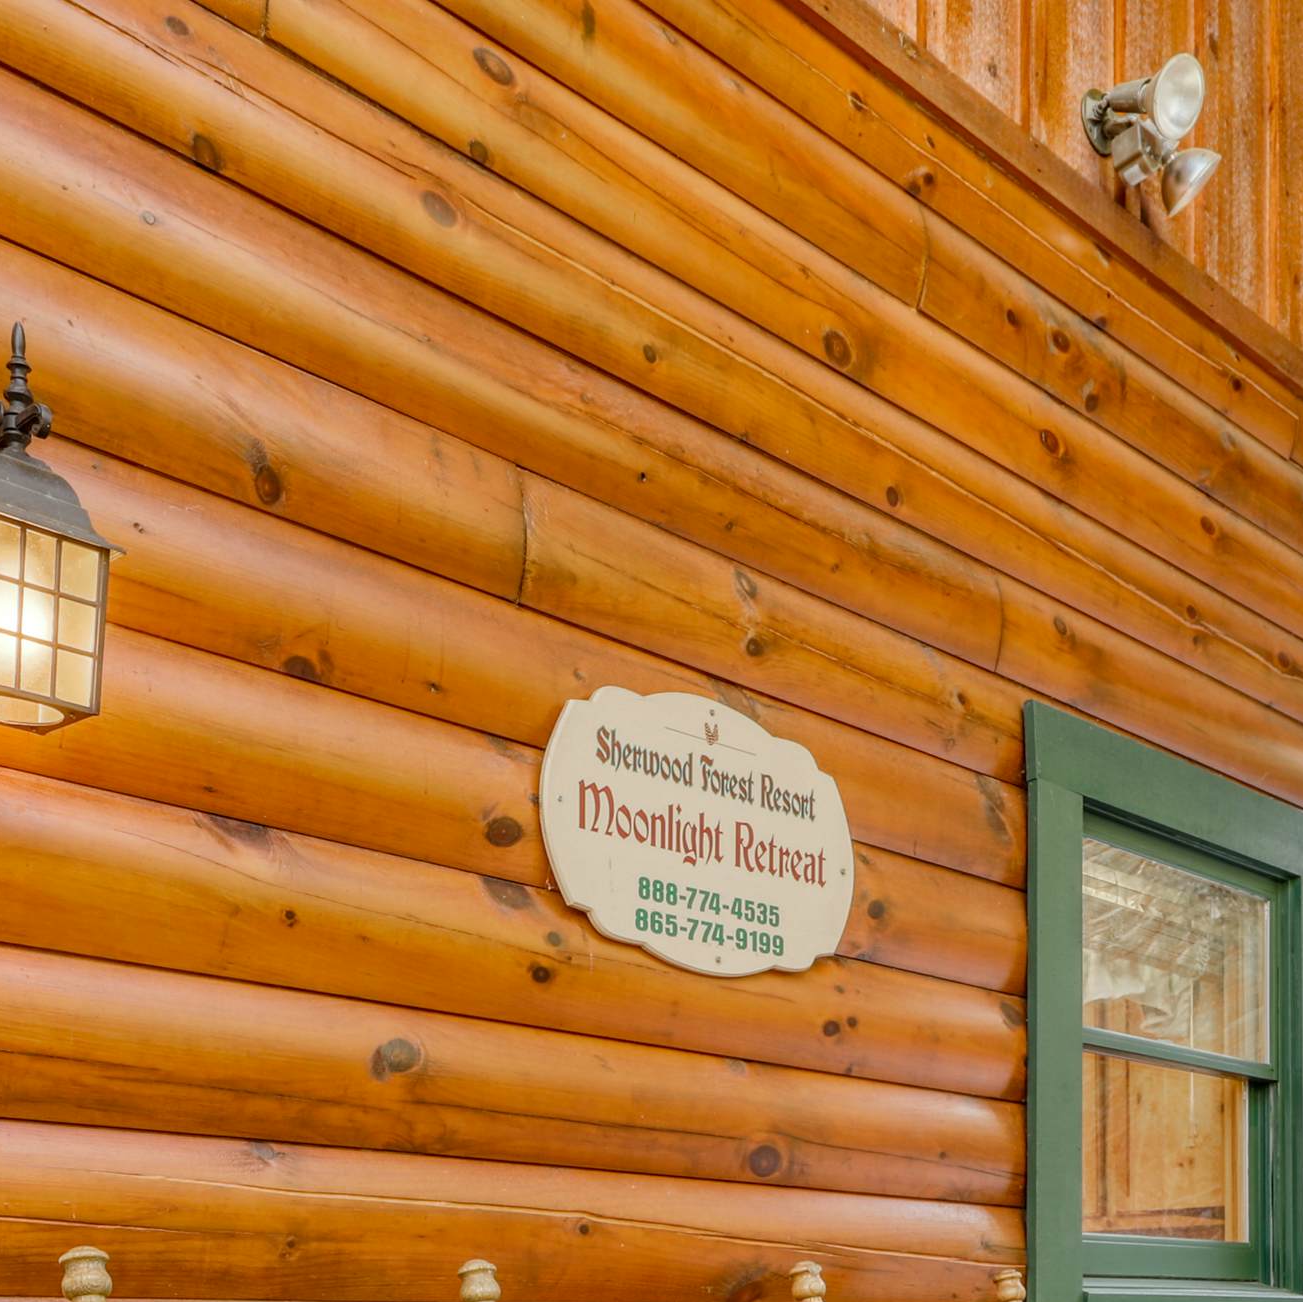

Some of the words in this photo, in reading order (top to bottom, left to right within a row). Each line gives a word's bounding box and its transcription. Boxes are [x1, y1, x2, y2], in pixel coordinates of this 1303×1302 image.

[596, 725, 694, 788] Sherwood
[699, 754, 755, 805] Forest
[760, 774, 817, 822] Resort
[578, 779, 723, 867] Moonlight
[734, 820, 827, 888] Retreat
[635, 908, 785, 957] 865-774-9199
[638, 876, 780, 928] 888-774-4535
